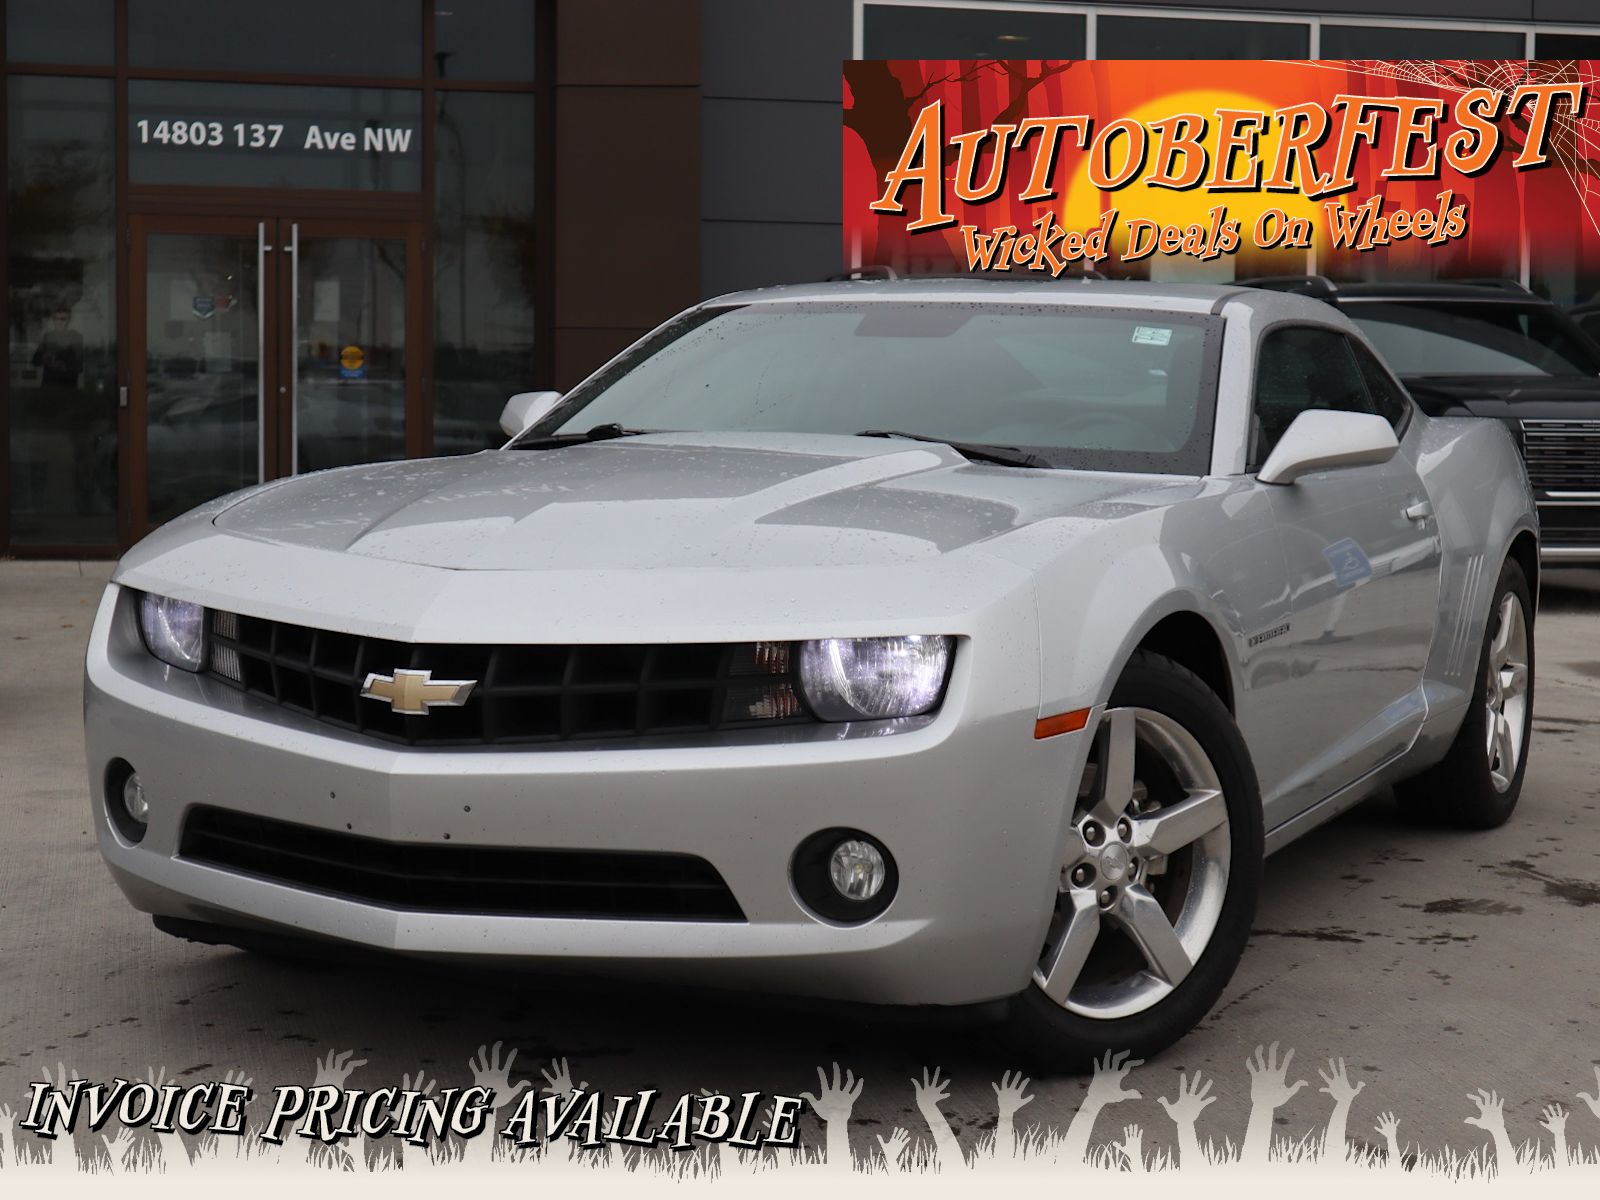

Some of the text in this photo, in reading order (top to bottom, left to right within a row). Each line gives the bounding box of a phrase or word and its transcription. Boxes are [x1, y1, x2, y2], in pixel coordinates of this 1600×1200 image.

[137, 120, 412, 152] 14803 137 Ave NW
